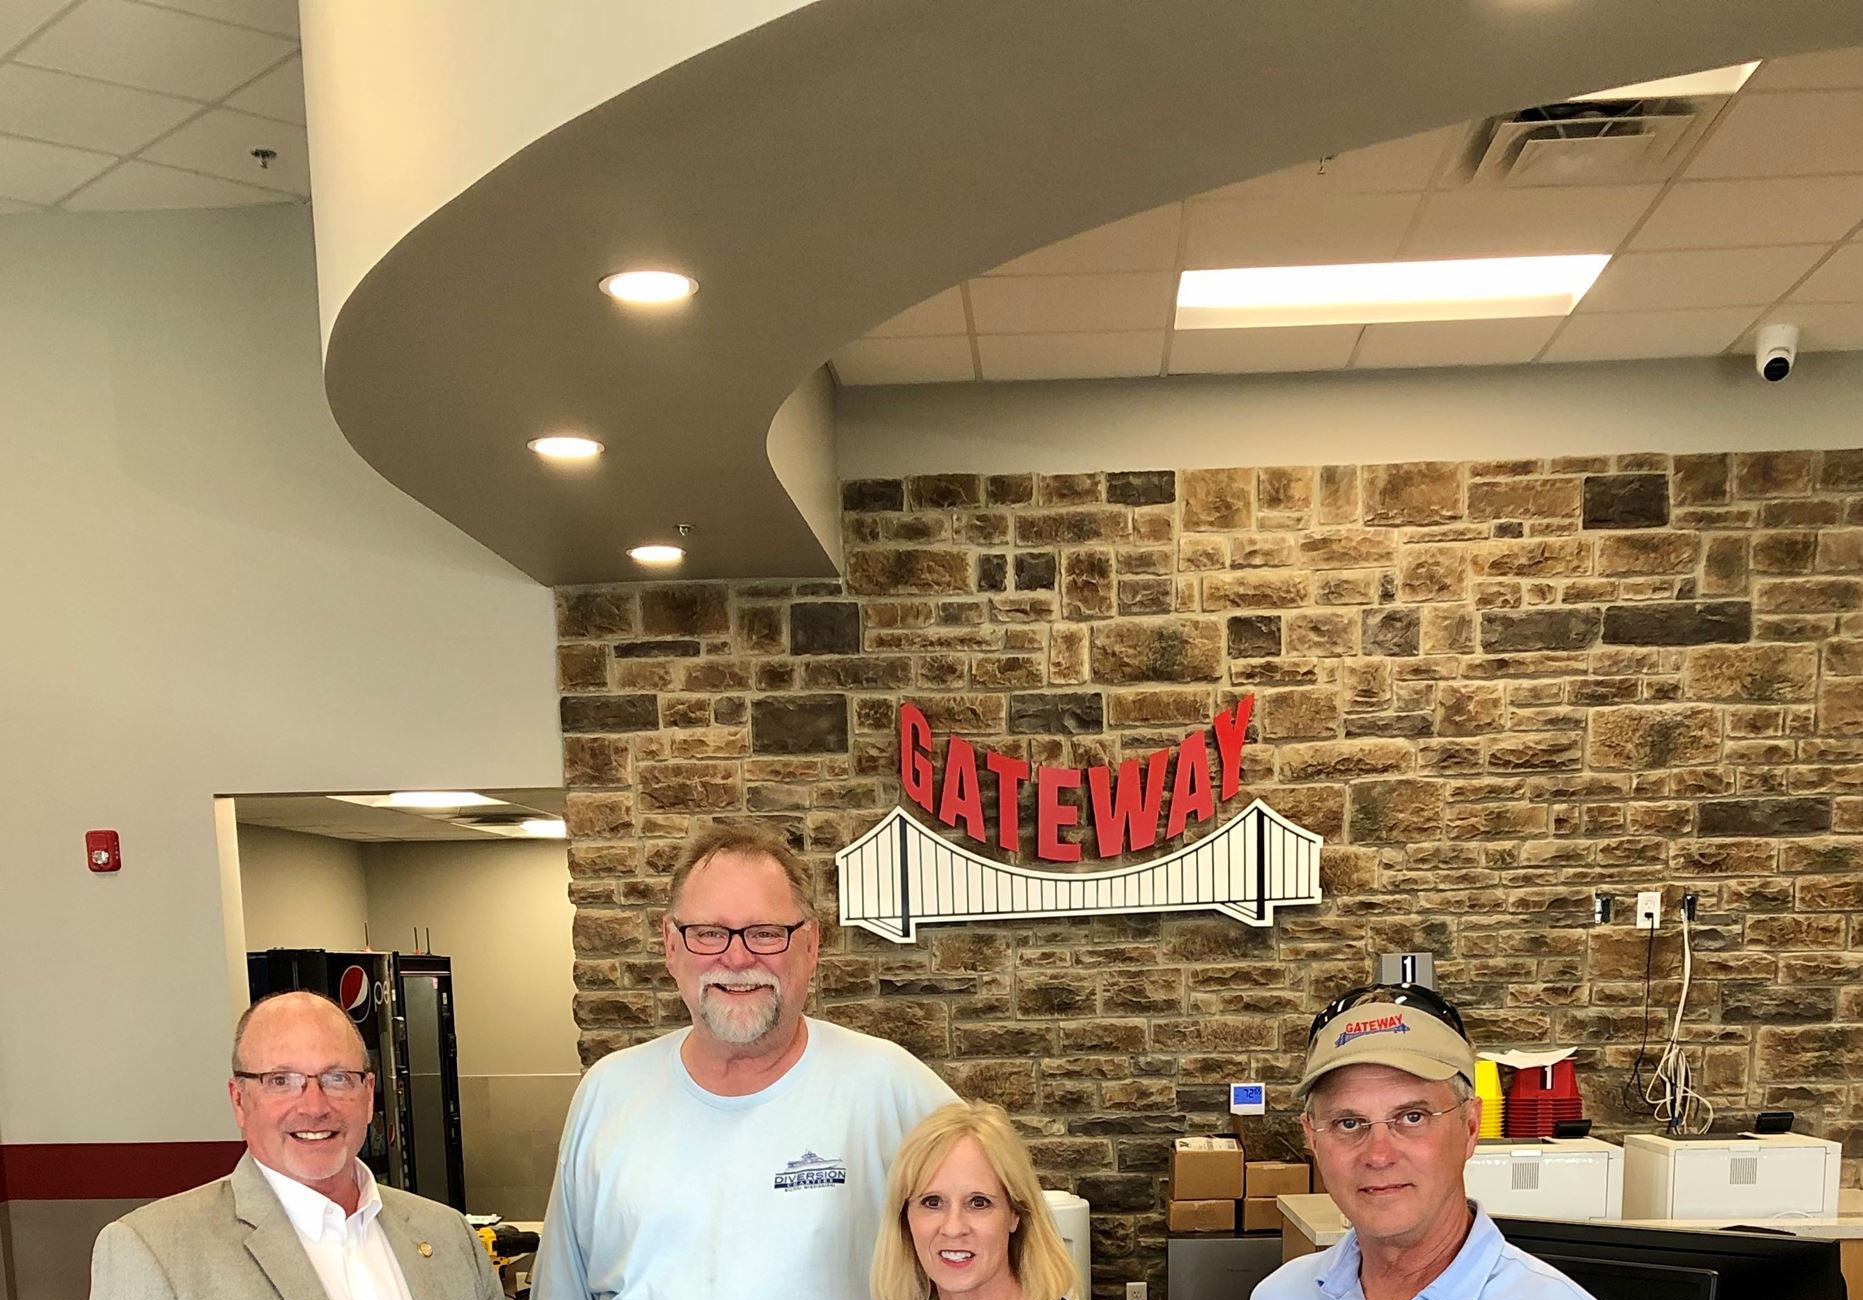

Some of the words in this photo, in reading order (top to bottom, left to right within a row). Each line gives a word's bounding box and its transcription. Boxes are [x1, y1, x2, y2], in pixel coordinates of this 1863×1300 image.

[900, 693, 1255, 862] GATEWAY
[1403, 956, 1412, 983] 1
[1346, 1014, 1402, 1033] GATEWAY
[1545, 1065, 1552, 1090] 1
[775, 1170, 846, 1184] DIVERSION
